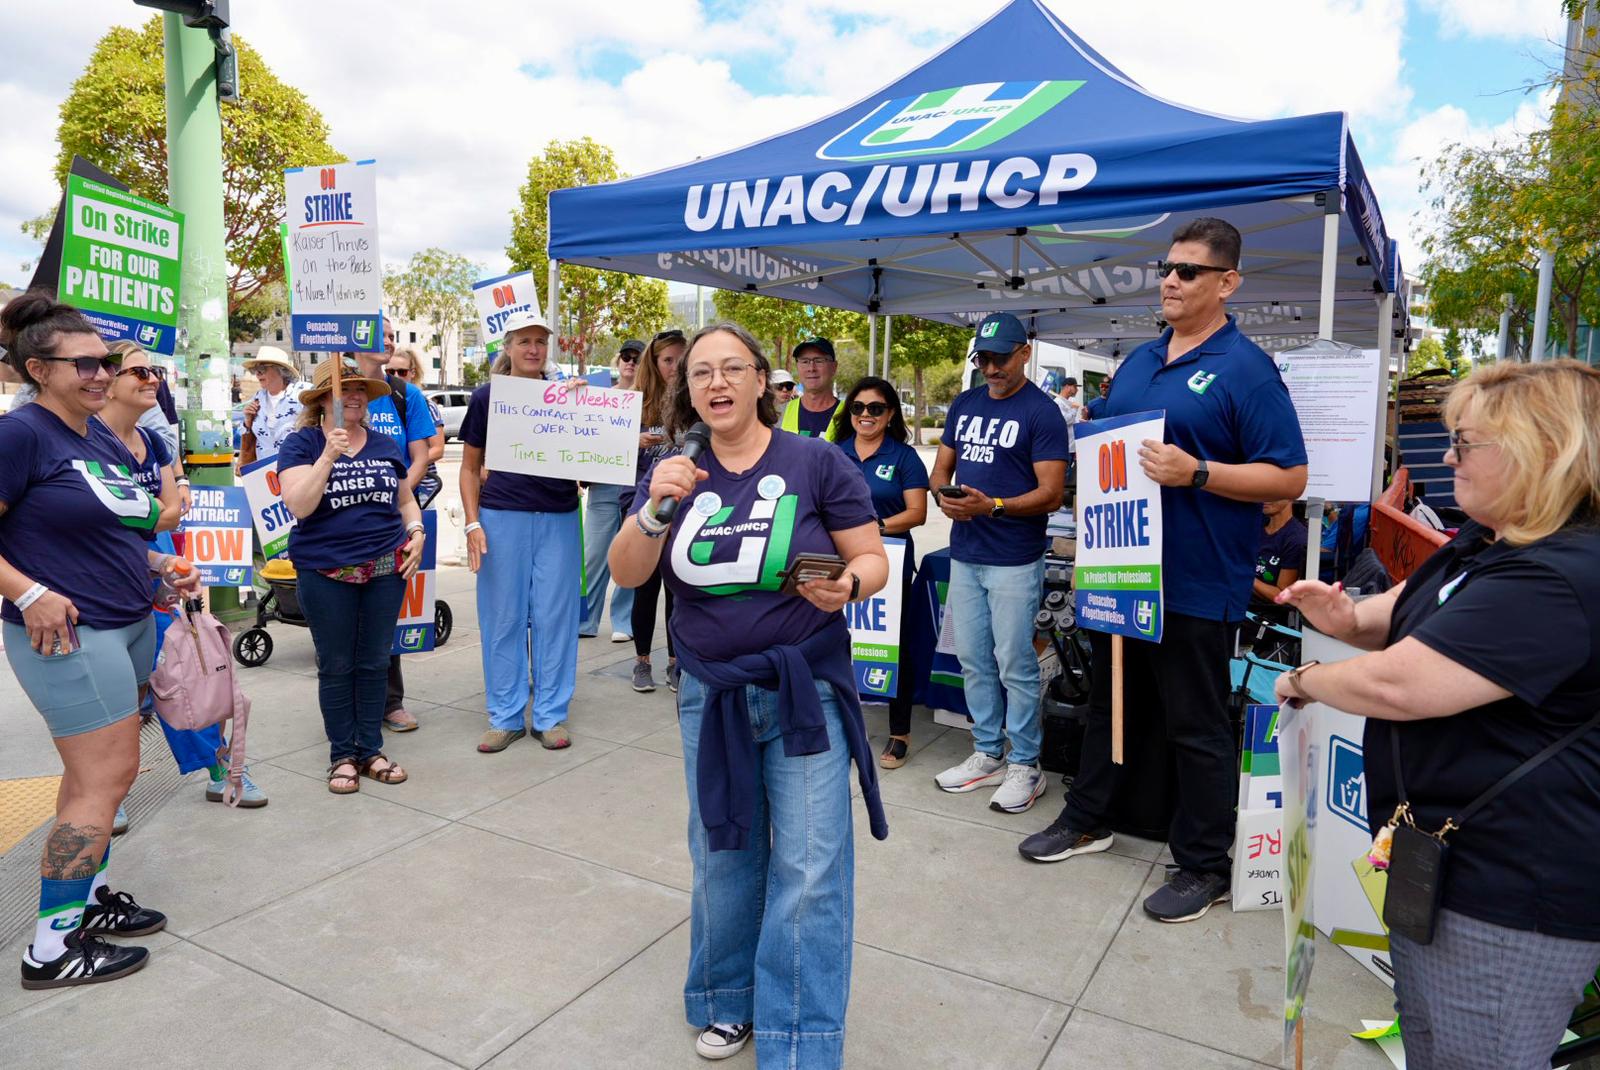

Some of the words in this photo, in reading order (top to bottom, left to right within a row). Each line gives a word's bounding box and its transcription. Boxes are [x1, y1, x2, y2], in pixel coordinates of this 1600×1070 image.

[891, 105, 1013, 125] UNAC/UHCP
[320, 168, 336, 190] ON
[684, 153, 1098, 232] UNAC/UHCP
[304, 192, 353, 223] STRIKE
[81, 205, 107, 232] On
[113, 213, 170, 248] Strike
[292, 232, 326, 252] Kaiser
[327, 230, 369, 252] Thrives
[89, 244, 123, 272] FOR
[127, 253, 160, 280] OUR
[325, 258, 347, 272] the
[65, 265, 174, 315] PATIENTS
[492, 284, 517, 308] ON
[300, 333, 348, 345] #TogetherWeRise
[543, 383, 568, 405] 68
[493, 400, 518, 415] THIS
[522, 404, 577, 421] CONTRACT
[584, 413, 604, 422] IS
[610, 415, 632, 429] WAY
[533, 423, 568, 435] OVER
[573, 426, 600, 436] DUE
[961, 444, 995, 464] 2025
[1098, 439, 1128, 494] ON
[323, 476, 375, 495] KAISER
[381, 476, 397, 487] TO
[190, 490, 225, 507] FAIR
[330, 491, 394, 509] DELIVER!
[180, 508, 240, 523] ONTRACT
[1084, 498, 1150, 550] STRIKE
[700, 522, 769, 537] UNAC/UHCP
[1083, 571, 1089, 584] To
[1089, 571, 1107, 584] Protect
[1107, 571, 1117, 583] Our
[1117, 570, 1152, 584] Professions
[1087, 592, 1117, 610] @unacuhcp
[1081, 605, 1125, 625] #TogetherWeRise
